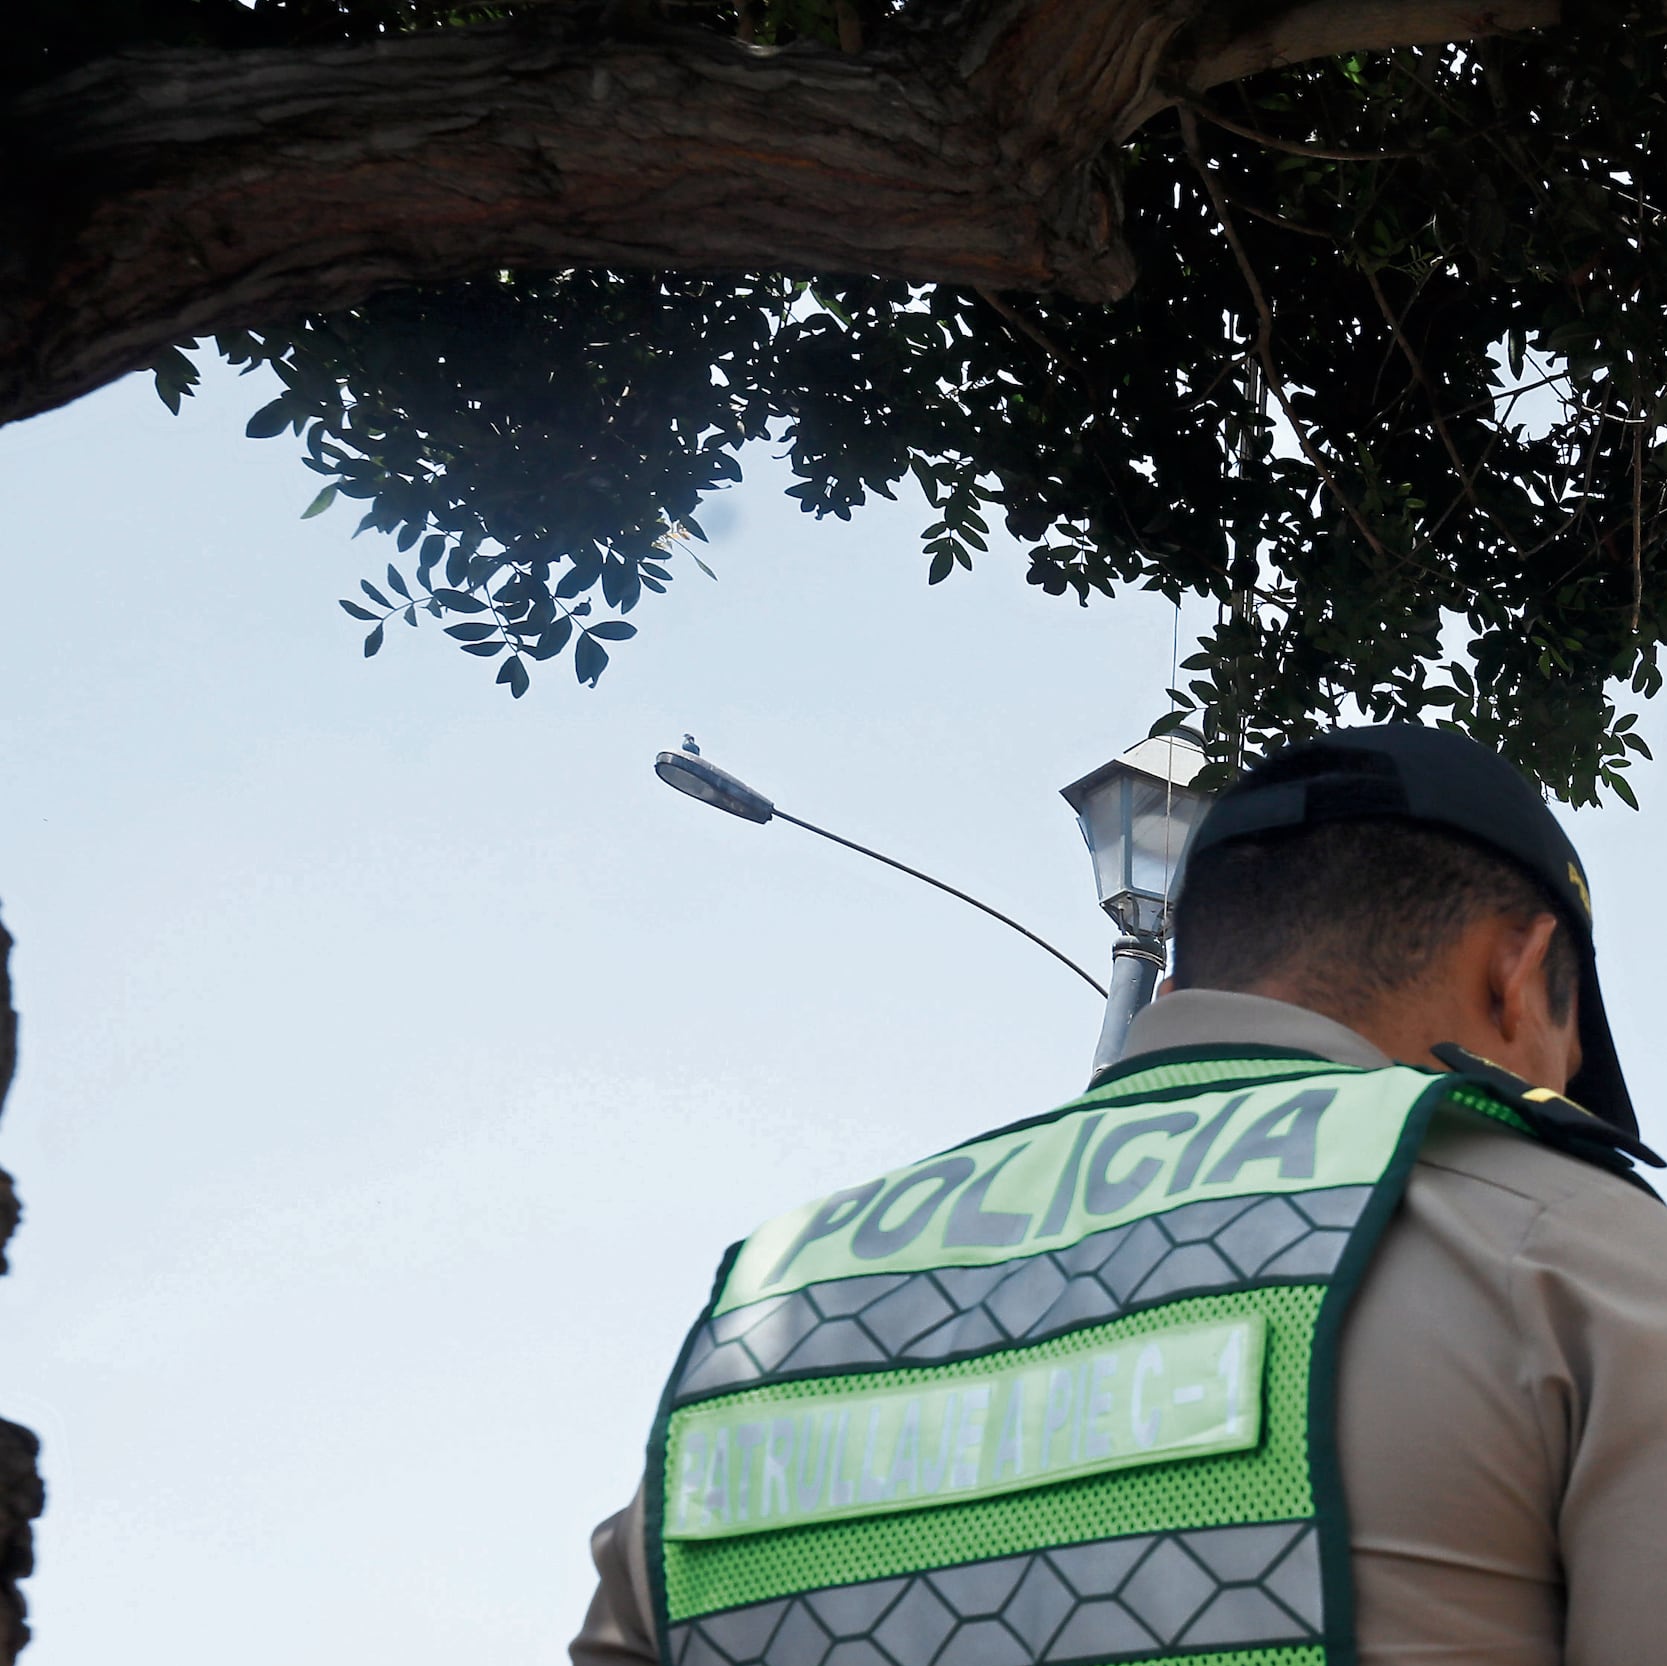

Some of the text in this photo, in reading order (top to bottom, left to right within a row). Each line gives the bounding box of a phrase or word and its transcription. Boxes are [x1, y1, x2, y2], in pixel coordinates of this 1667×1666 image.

[760, 1088, 1338, 1287] POLICIA
[678, 1382, 993, 1529] PATRULLAJE
[993, 1378, 1026, 1481] A
[1042, 1356, 1117, 1468] PIE
